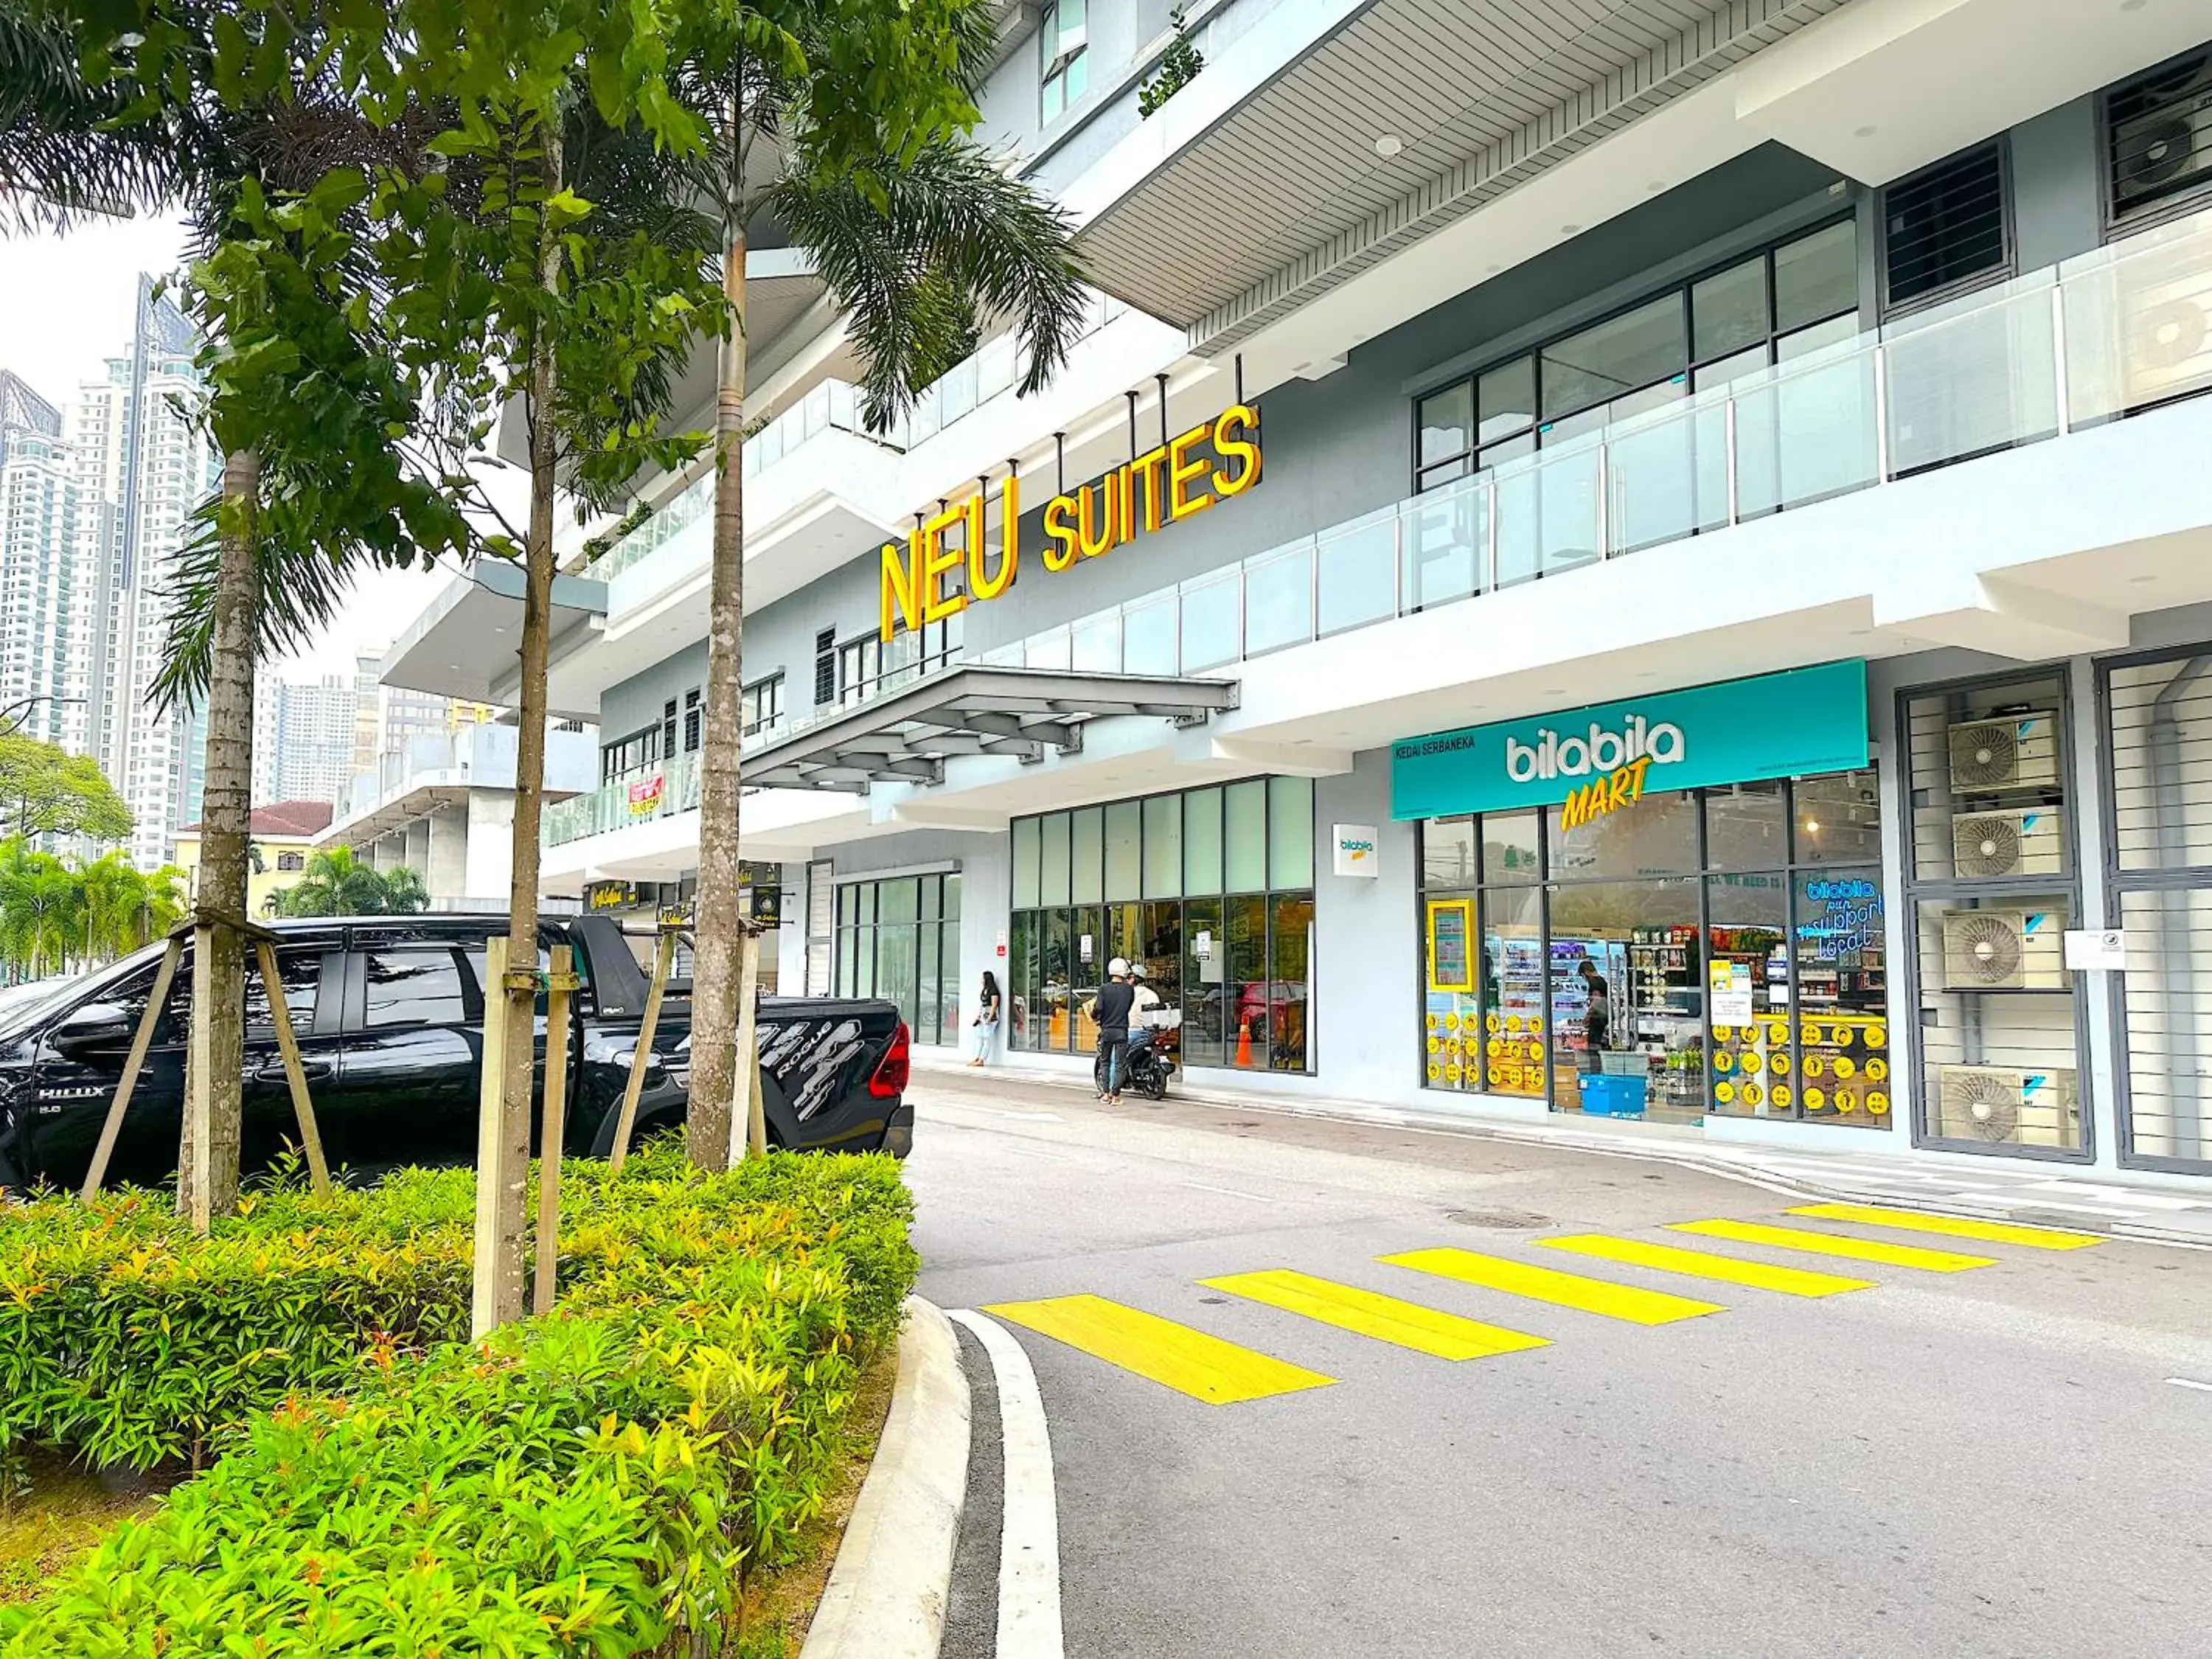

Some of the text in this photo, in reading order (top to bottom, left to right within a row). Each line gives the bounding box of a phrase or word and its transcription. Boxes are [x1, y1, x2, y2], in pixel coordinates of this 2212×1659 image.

[880, 404, 1263, 644] NEU SUITES
[1396, 735, 1475, 760] KEDAI SERBANEKA
[1506, 713, 1686, 783] bilabila
[1561, 756, 1653, 832] MART
[1806, 880, 1875, 900] bilabila
[1797, 894, 1883, 941] #support
[1819, 924, 1871, 959] local
[39, 1086, 106, 1099] HILUX
